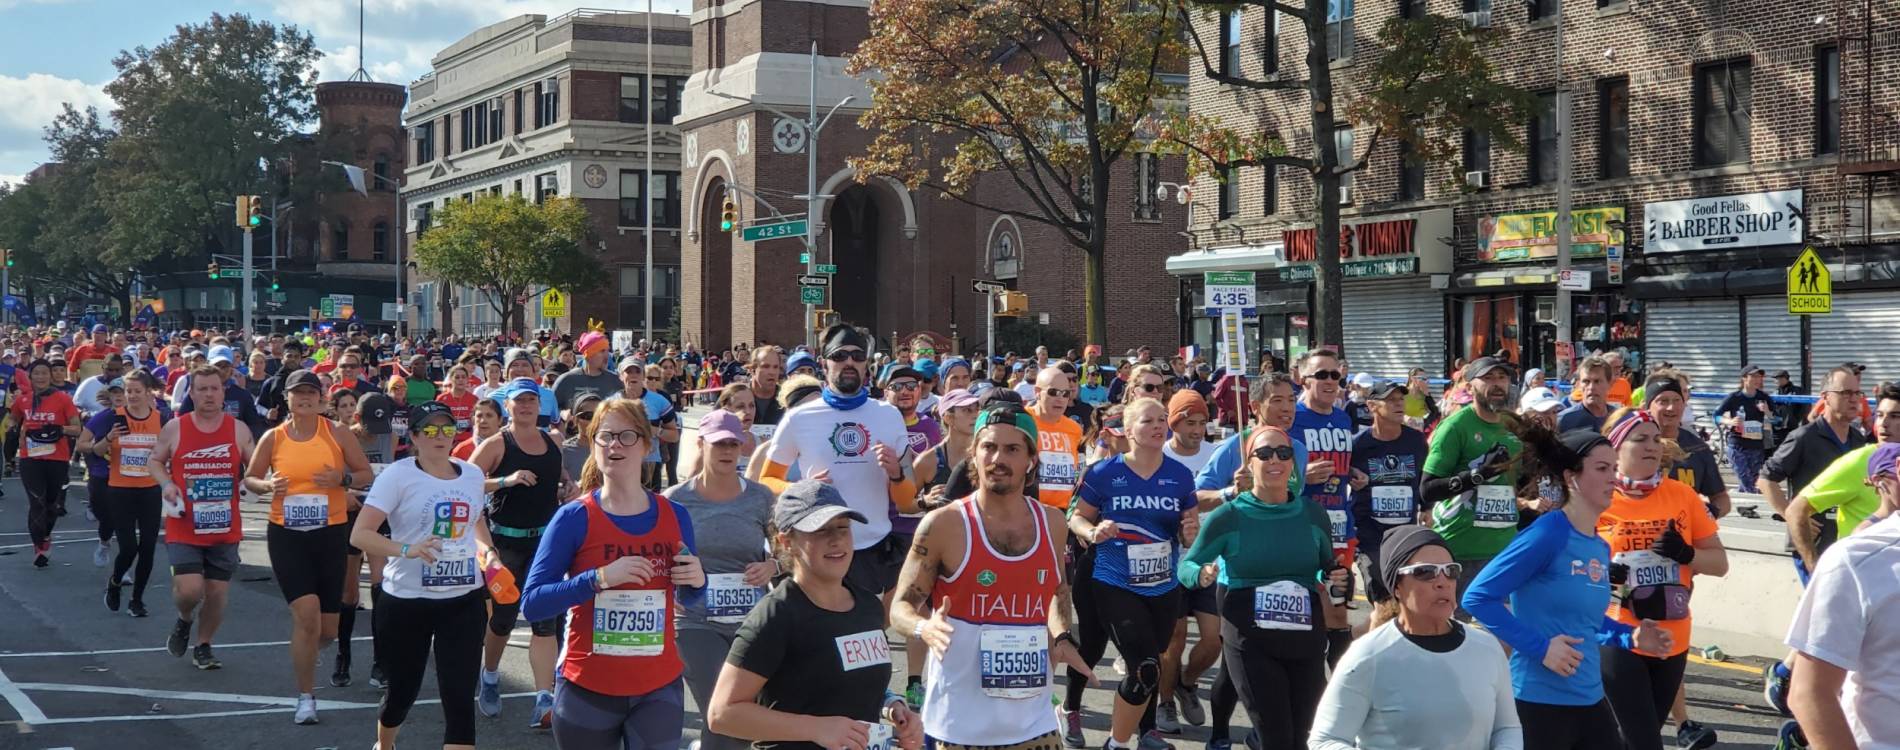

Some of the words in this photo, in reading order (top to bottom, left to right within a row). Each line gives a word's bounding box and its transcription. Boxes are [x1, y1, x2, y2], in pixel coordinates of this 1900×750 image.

[1692, 202, 1718, 216] Good
[1720, 200, 1750, 213] Fellas
[758, 228, 774, 237] 42
[778, 226, 792, 235] St
[1533, 212, 1603, 237] FLIST
[1662, 216, 1731, 240] BARBER
[1735, 211, 1783, 234] SHOP
[1356, 219, 1417, 256] YUMMY
[1345, 264, 1367, 276] Deliver
[1213, 293, 1247, 305] 4:35
[1792, 298, 1827, 308] SCHOOL
[25, 409, 55, 421] Vera
[842, 432, 856, 444] UAE
[184, 462, 232, 470] AMBASSADOR
[1047, 464, 1068, 476] 58413
[206, 488, 232, 496] Focus
[292, 505, 319, 519] 58061
[1112, 496, 1180, 512] FRANCE
[1381, 498, 1405, 510] 56157
[1484, 499, 1510, 513] 57634
[200, 511, 226, 523] 60099
[604, 541, 673, 560] FALLON
[436, 560, 464, 576] 57171
[1139, 556, 1168, 574] 57746
[1636, 566, 1667, 584] 69191
[716, 589, 753, 605] 56355
[1265, 593, 1303, 613] 55628
[971, 594, 1045, 618] ITALIA
[596, 609, 604, 629] 2019
[608, 611, 655, 631] 67359
[843, 636, 888, 664] ERIKA
[995, 652, 1039, 673] 55599
